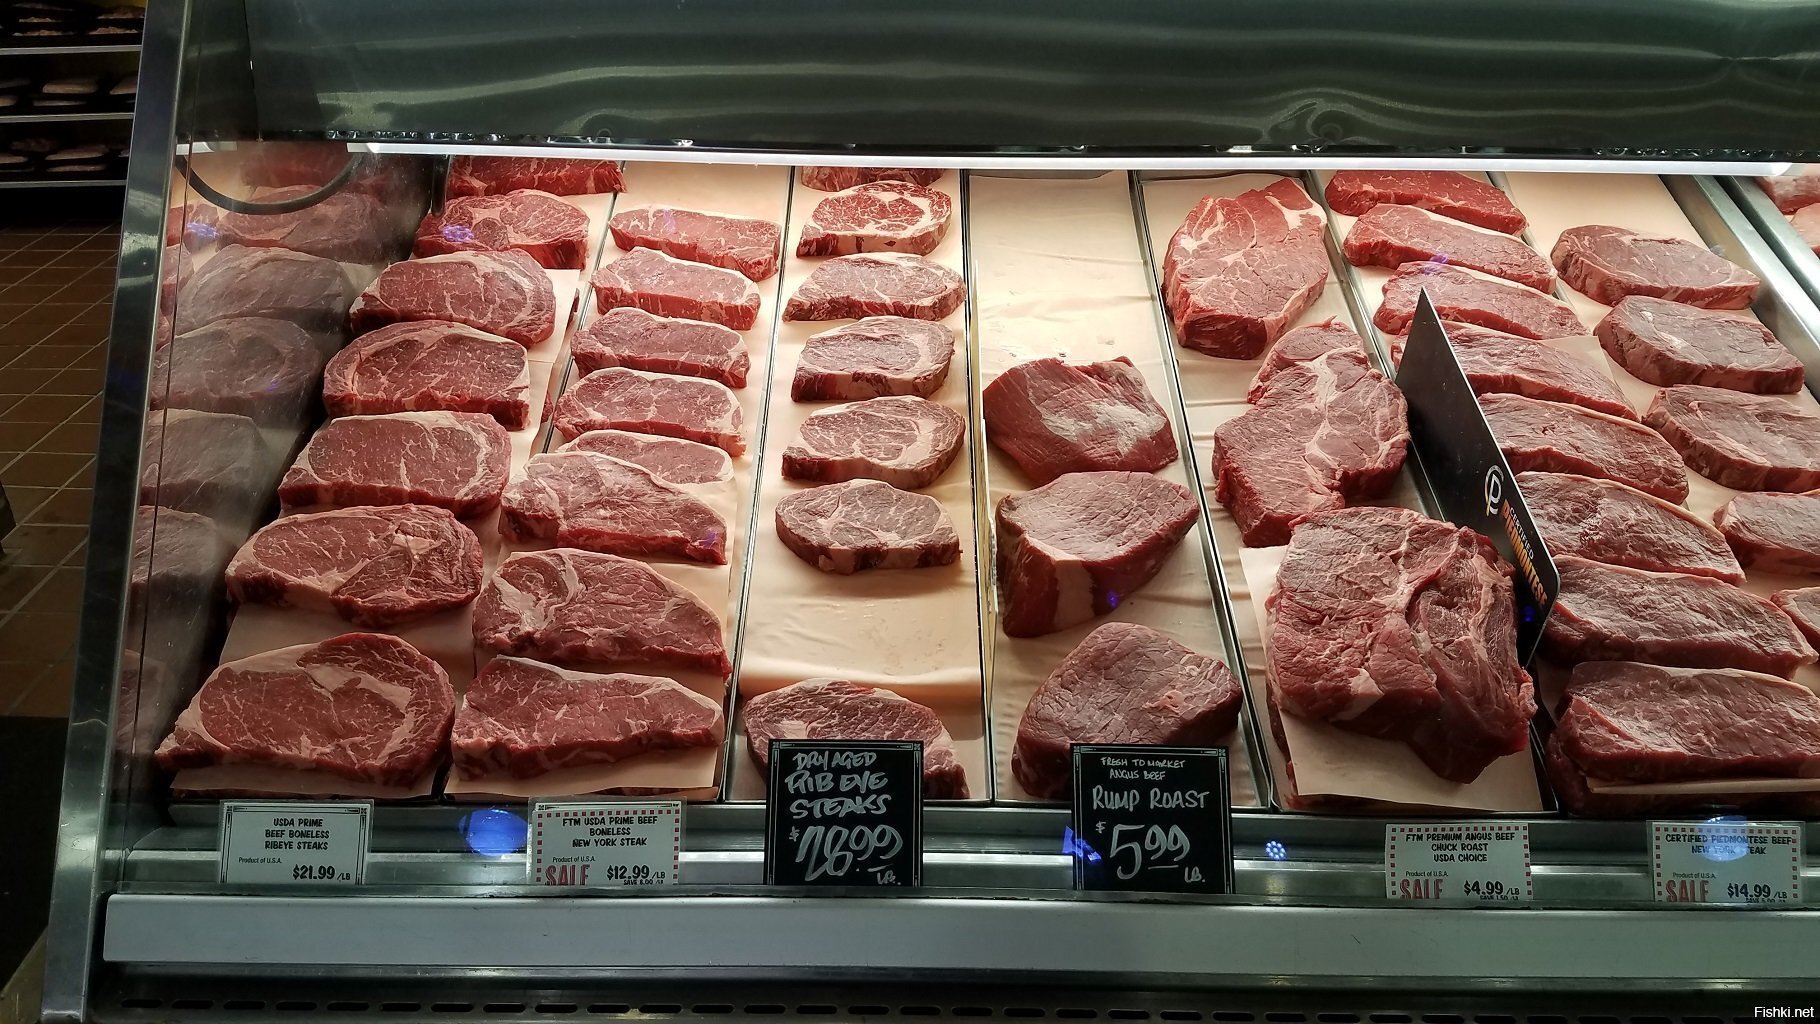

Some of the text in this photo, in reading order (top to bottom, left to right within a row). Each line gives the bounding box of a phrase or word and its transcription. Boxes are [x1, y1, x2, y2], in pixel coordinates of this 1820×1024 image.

[1510, 507, 1534, 560] CERTIFIED
[792, 751, 877, 770] DRY AGED
[1100, 756, 1128, 766] FRESH
[1147, 760, 1186, 768] MARKET
[1110, 769, 1166, 780] ANGUS BEEF
[784, 770, 888, 794] RIB EYE
[1092, 784, 1210, 812] RUMP ROAST
[789, 794, 892, 819] STEAKS
[273, 818, 324, 827] USDA PRIME
[562, 816, 658, 826] FTM USDA PRIME BEEF
[265, 829, 330, 839] BEEF BONELESS
[590, 828, 631, 836] BONELESS
[572, 837, 647, 847] NEW YORK STEAK
[1666, 834, 1792, 844] CERTIFIED PIEDMONTESE BEEF
[265, 841, 328, 850] RIBEYE STEAKS
[1431, 843, 1488, 851] CHUCK ROAST
[1434, 854, 1487, 862] USDA CHOICE
[292, 864, 335, 880] $21.99
[606, 865, 650, 880] $12.99
[1464, 880, 1503, 896] $4.99
[1727, 883, 1771, 898] $14.99
